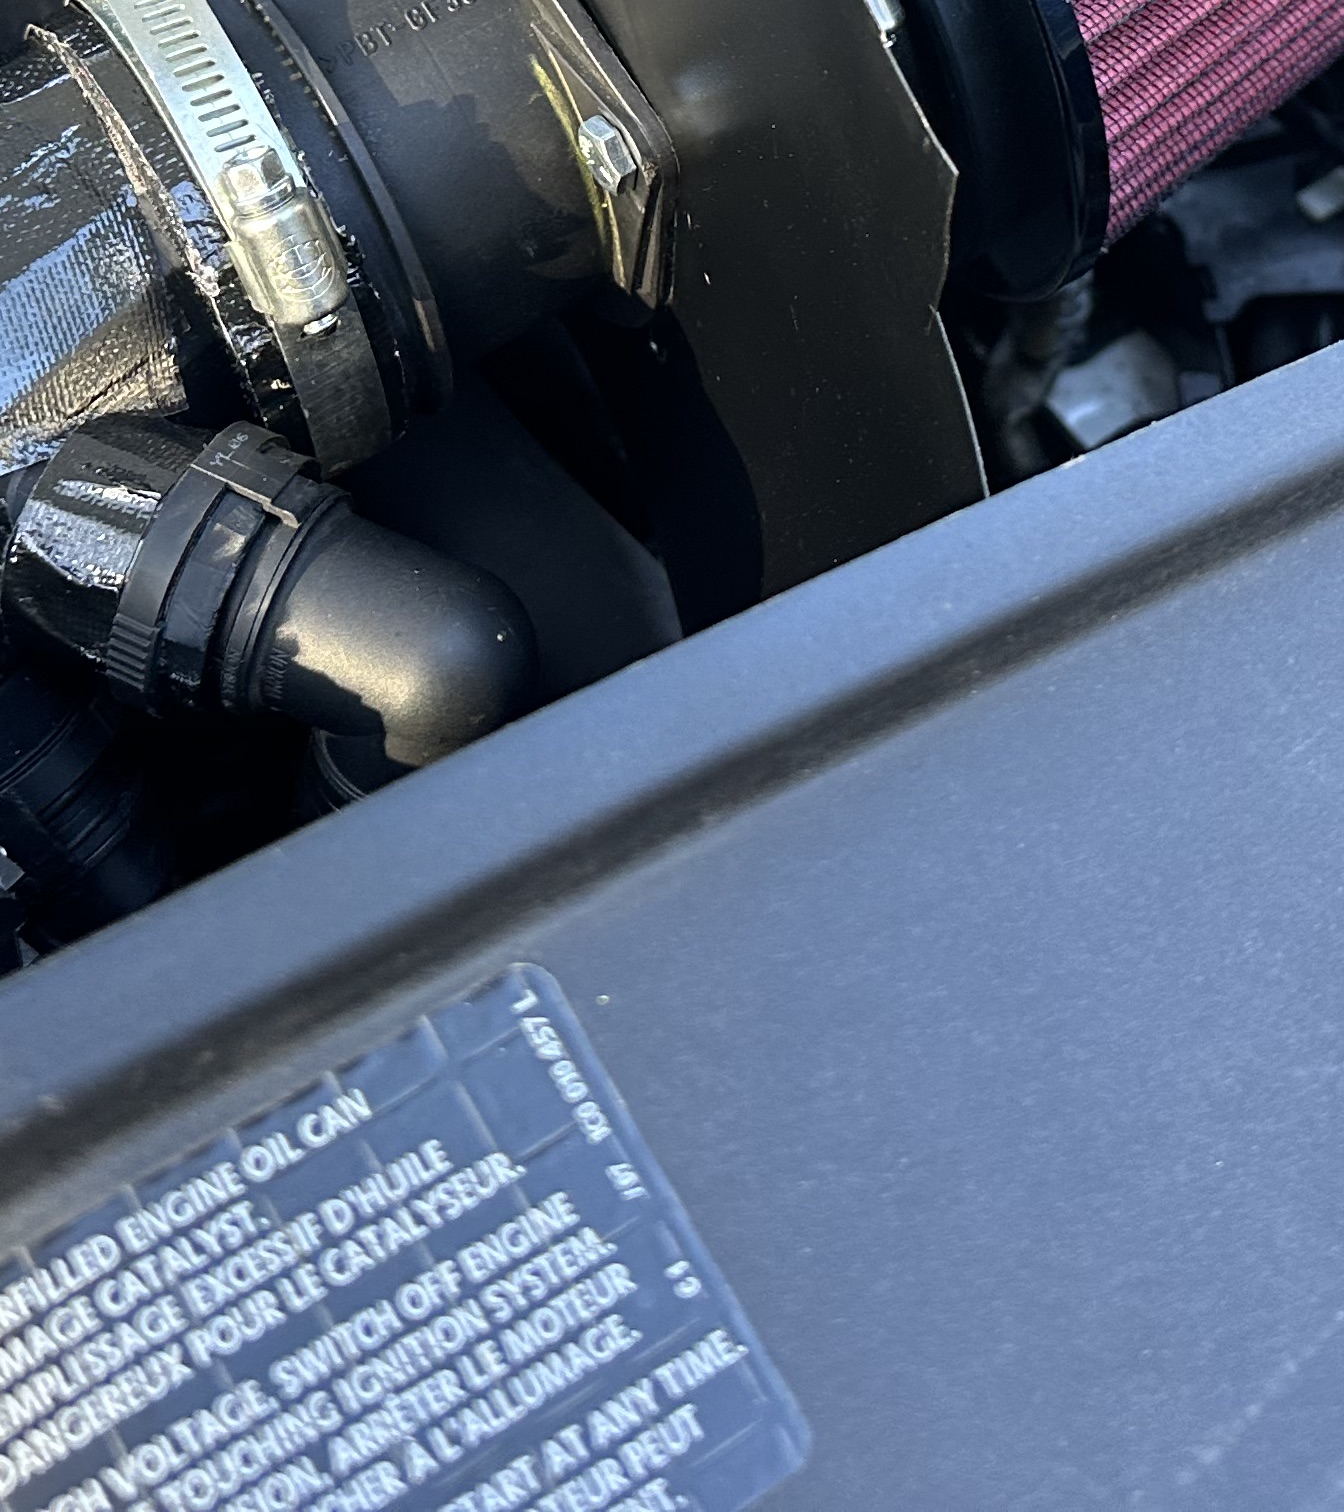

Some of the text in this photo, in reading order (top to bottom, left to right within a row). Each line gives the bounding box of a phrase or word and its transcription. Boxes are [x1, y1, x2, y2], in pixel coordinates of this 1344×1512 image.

[114, 1161, 248, 1255] ENGINE
[239, 1131, 306, 1183] OIL
[296, 1087, 374, 1148] CAN
[179, 1210, 324, 1318] EXCESSIF
[317, 1138, 455, 1238] D'HUILE
[92, 1199, 273, 1319] CATALYST.
[182, 1289, 288, 1369] POUR
[273, 1262, 329, 1314] LE
[316, 1151, 528, 1288] CATALYSEUR.
[268, 1298, 404, 1401] SWITCH
[394, 1259, 462, 1322] OFF
[456, 1191, 581, 1284] ENGINE
[455, 1338, 508, 1390] LE
[498, 1262, 639, 1366] MOTEUR
[156, 1225, 619, 1512] TOUCHING IGNITION SYSTEM.
[425, 1313, 644, 1465] L'ALLUMAGE.
[540, 1423, 591, 1486] AT
[586, 1377, 661, 1451] ANY
[654, 1328, 749, 1401] TIME.
[618, 1402, 705, 1481] PEUT
